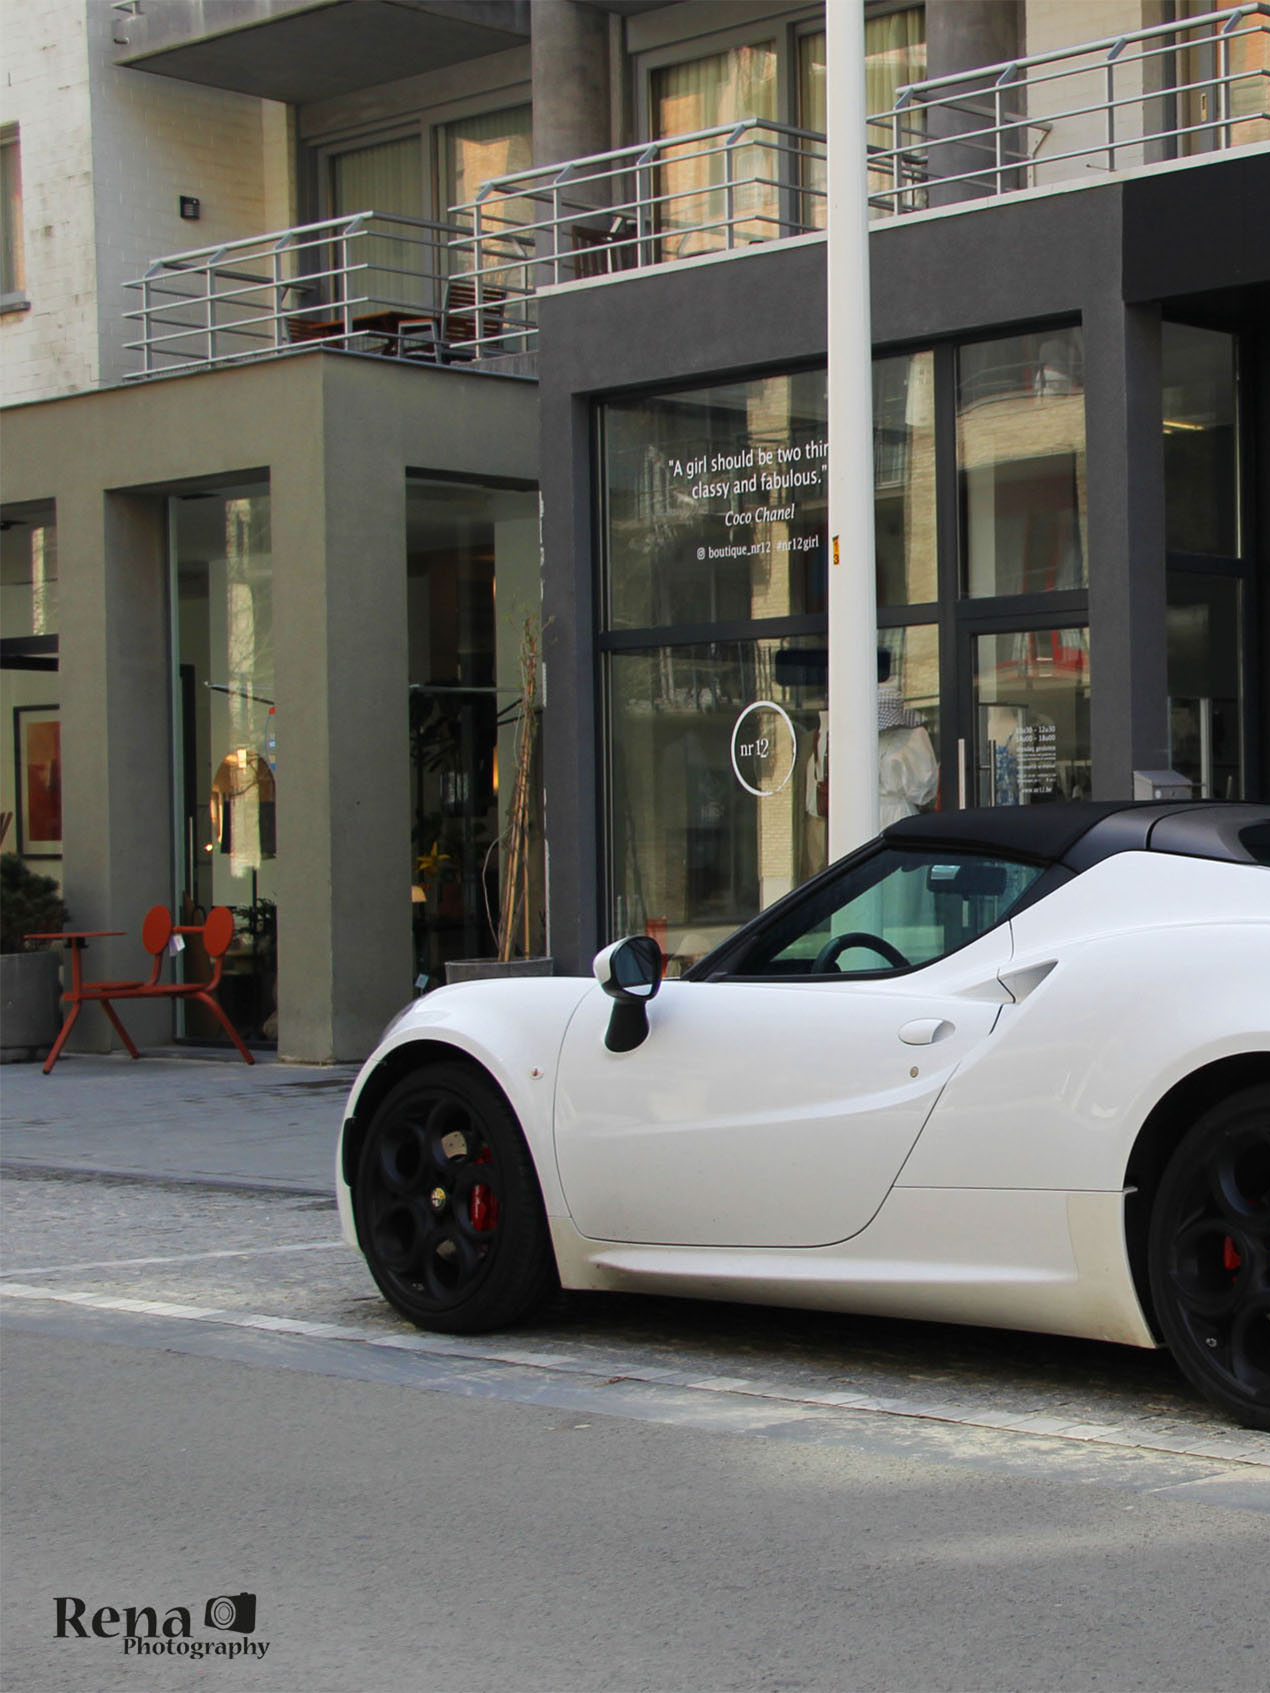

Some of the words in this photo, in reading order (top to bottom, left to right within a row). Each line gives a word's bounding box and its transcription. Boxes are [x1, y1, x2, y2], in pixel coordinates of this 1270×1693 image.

[686, 455, 707, 479] girl
[711, 450, 753, 472] should
[758, 447, 773, 465] be
[777, 446, 801, 463] two
[692, 481, 730, 500] classy
[733, 474, 757, 494] and
[725, 510, 751, 527] Coco
[755, 503, 795, 523] Chanel
[708, 541, 771, 559] boutique_nr12
